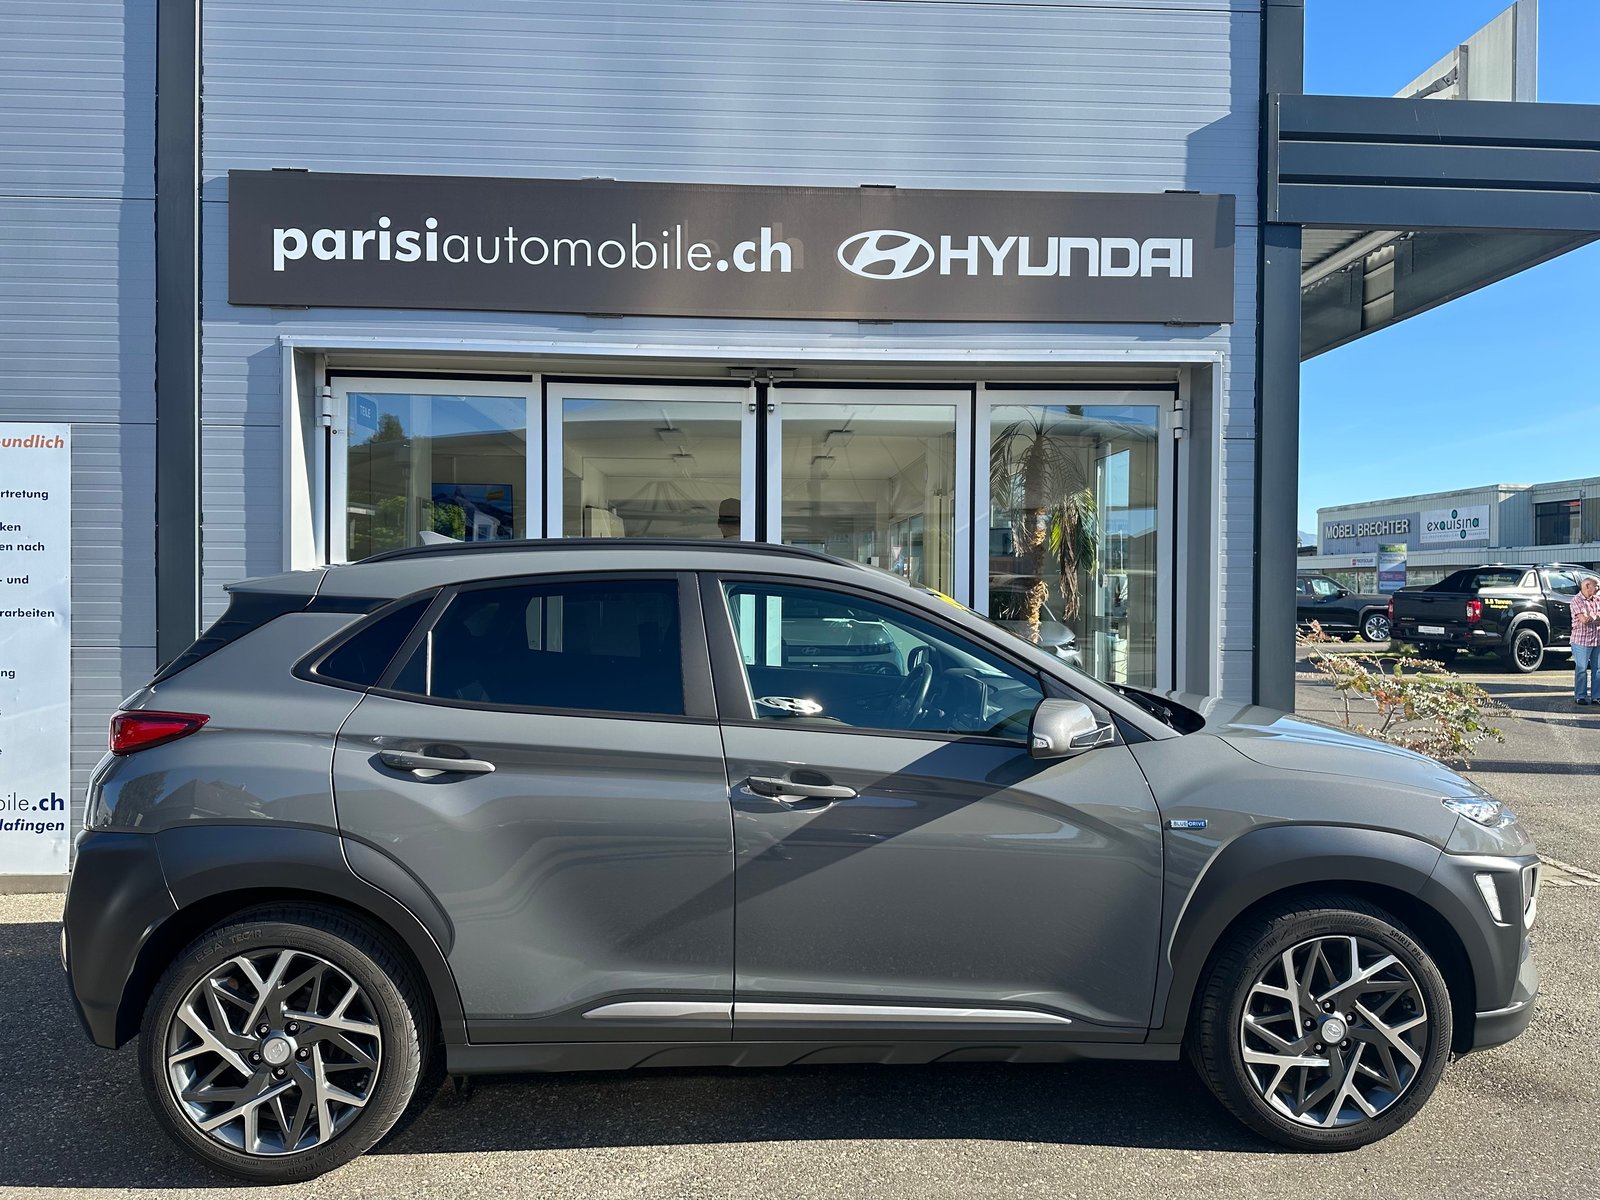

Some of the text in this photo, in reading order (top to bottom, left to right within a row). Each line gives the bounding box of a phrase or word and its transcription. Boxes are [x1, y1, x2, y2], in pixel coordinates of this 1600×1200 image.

[272, 216, 792, 273] parisiautomobile.ch
[939, 234, 1193, 278] HYUNDAI
[0, 434, 65, 449] undlich
[1325, 523, 1356, 539] MÖBEL
[1357, 519, 1410, 537] BRECHTER
[17, 541, 45, 551] nach
[7, 574, 29, 584] und
[1389, 930, 1425, 961] SPIRIT PRO
